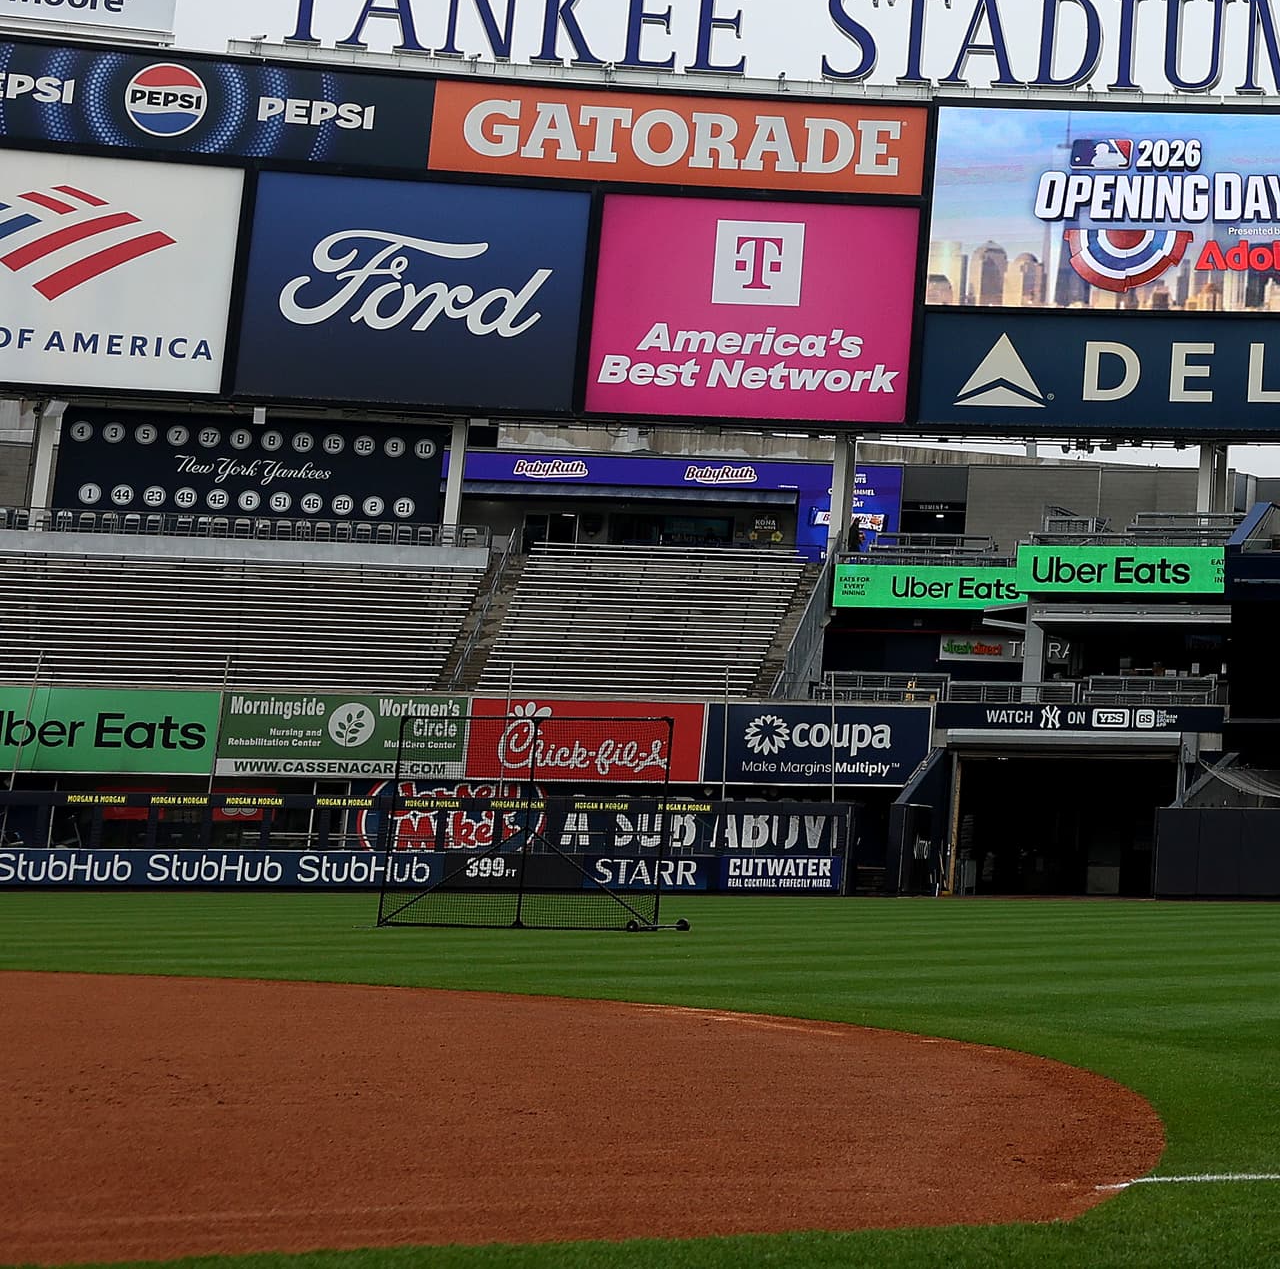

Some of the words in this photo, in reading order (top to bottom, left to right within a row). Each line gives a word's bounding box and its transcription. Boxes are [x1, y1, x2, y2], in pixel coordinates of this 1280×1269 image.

[0, 73, 75, 104] PSI
[130, 89, 203, 109] PEPSI
[257, 97, 375, 130] PEPSI
[463, 99, 901, 176] GATORADE
[1136, 139, 1202, 171] 2026
[1034, 171, 1209, 222] OPENING
[1228, 227, 1273, 236] Presented
[279, 230, 552, 337] Ford
[0, 326, 35, 349] OF
[44, 331, 212, 360] AMERICA
[637, 323, 863, 358] America's
[598, 355, 700, 387] Best
[704, 359, 899, 393] Network
[175, 455, 215, 473] New
[214, 457, 262, 483] York
[261, 460, 331, 485] Yankees
[1032, 556, 1107, 584] Uber
[1114, 557, 1191, 584] Eats
[892, 576, 953, 599] Uber
[958, 577, 1020, 599] Eats
[230, 696, 325, 719] Morningside
[379, 699, 460, 716] Workmen's
[987, 710, 1033, 723] WATCH
[1067, 711, 1086, 724] ON
[1099, 714, 1124, 723] YES
[0, 710, 85, 748] ber
[94, 712, 206, 750] Eats
[270, 728, 305, 738] Nursing
[306, 728, 322, 737] and
[413, 718, 457, 737] Circle
[228, 738, 289, 747] Rehabilitation
[292, 739, 321, 747] Center
[427, 740, 457, 749] Center
[791, 723, 891, 757] coupa
[234, 760, 446, 775] WWW.CASSENACARE.COM
[742, 761, 777, 772] Make
[780, 762, 832, 776] Margins
[68, 796, 93, 804] MORGAN
[100, 796, 125, 804] MORGAN
[151, 796, 176, 804] MORGAN
[183, 796, 208, 804] MORGAN
[317, 799, 341, 807] MORGAN
[348, 799, 372, 807] MORGAN
[0, 853, 132, 881] StubHub
[147, 853, 283, 883] StubHub
[297, 855, 431, 884] StubHub
[466, 857, 504, 878] 399
[594, 858, 697, 886] STARR
[729, 858, 832, 876] CUTWATER
